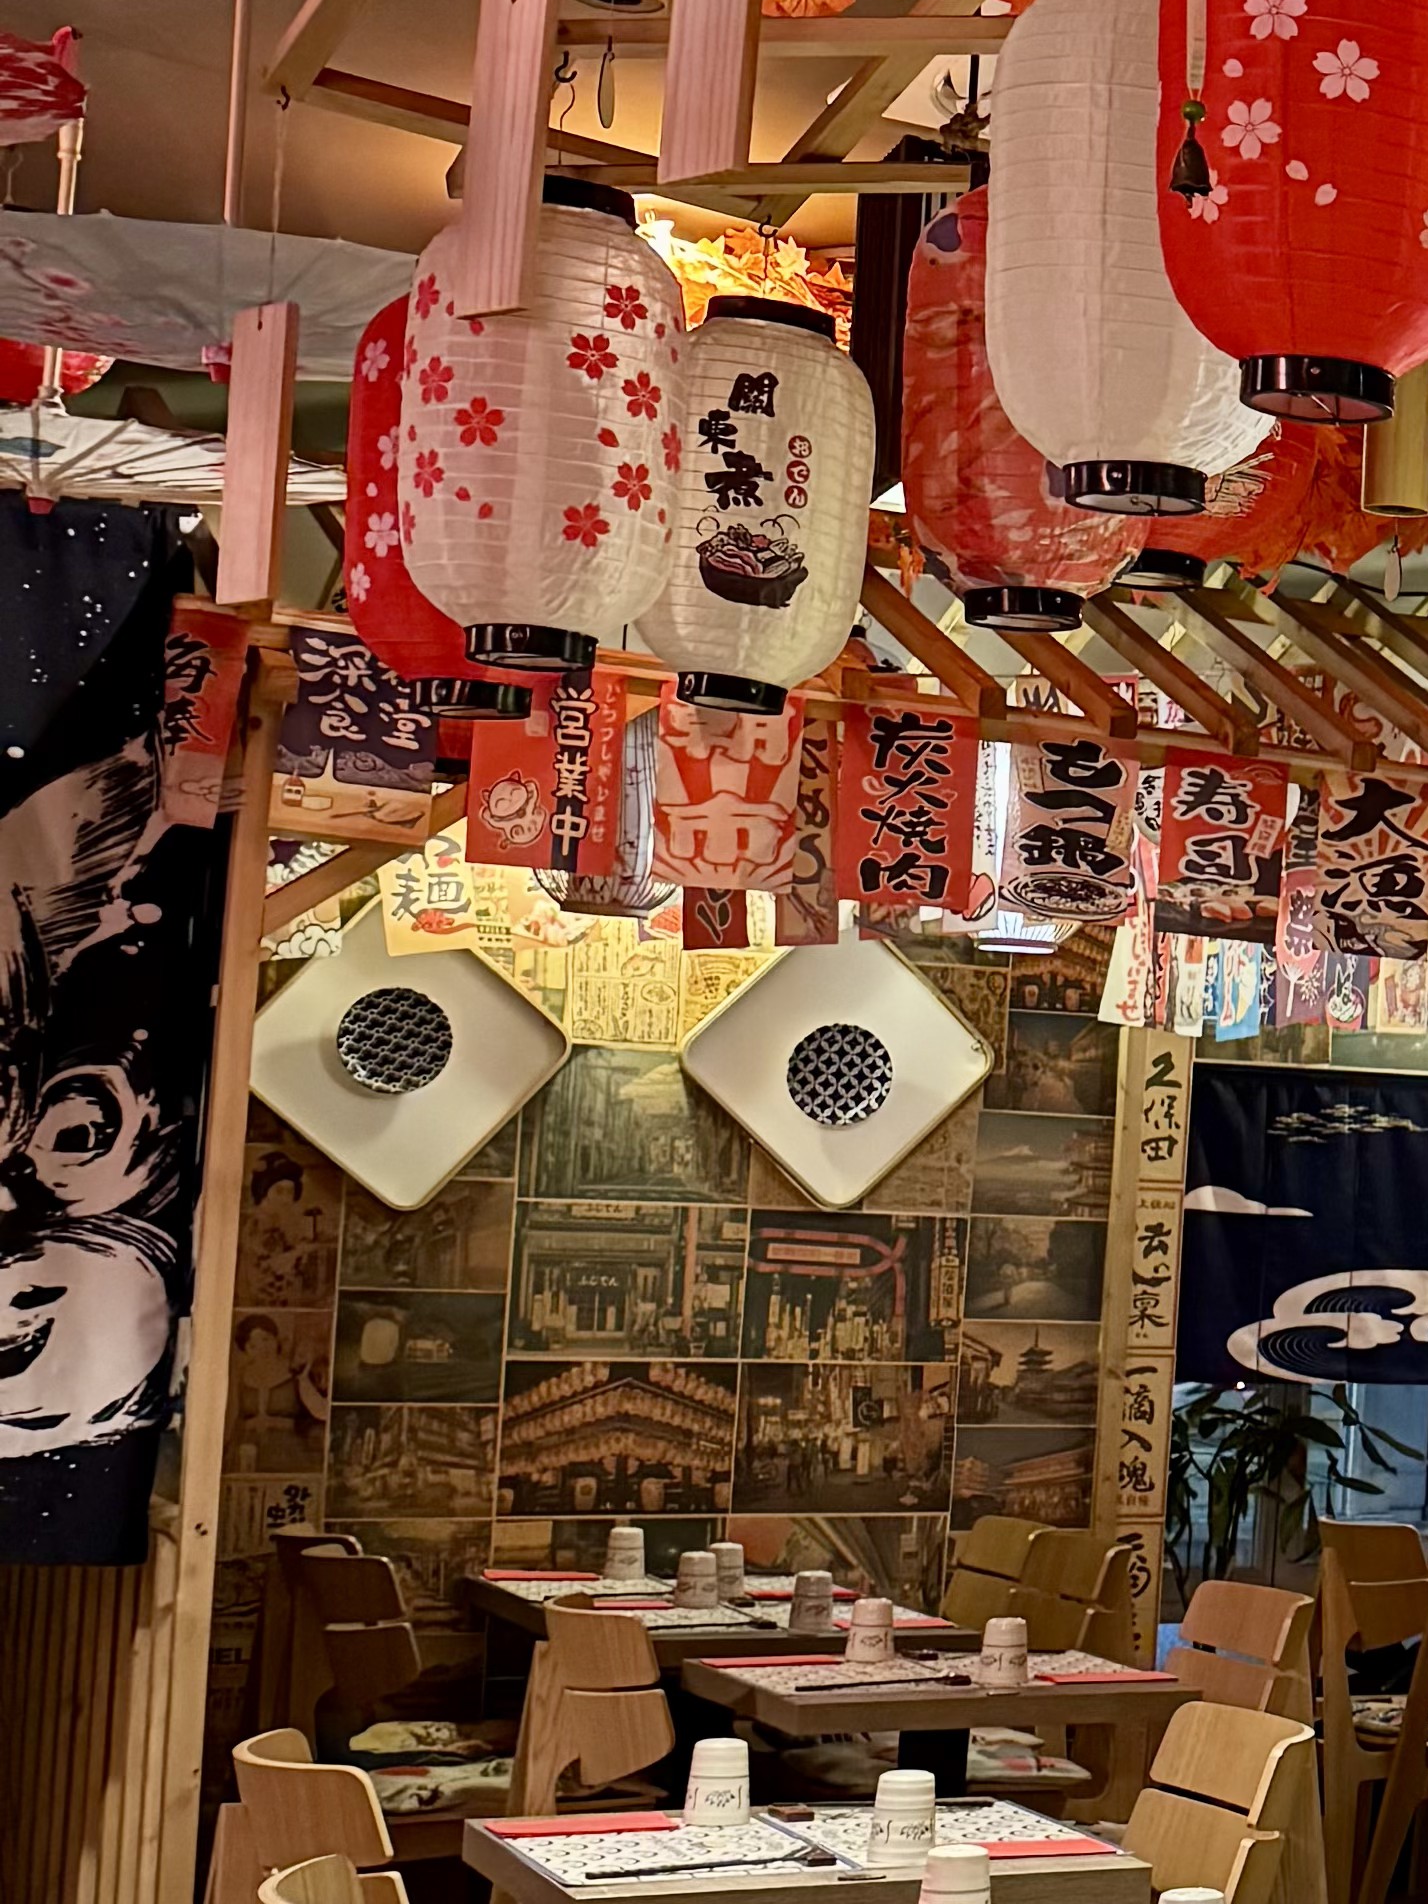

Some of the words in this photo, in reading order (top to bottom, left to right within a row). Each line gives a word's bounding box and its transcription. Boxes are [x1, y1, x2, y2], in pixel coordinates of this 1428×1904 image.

[550, 686, 598, 856] 営業中
[1174, 765, 1263, 884] 寿司
